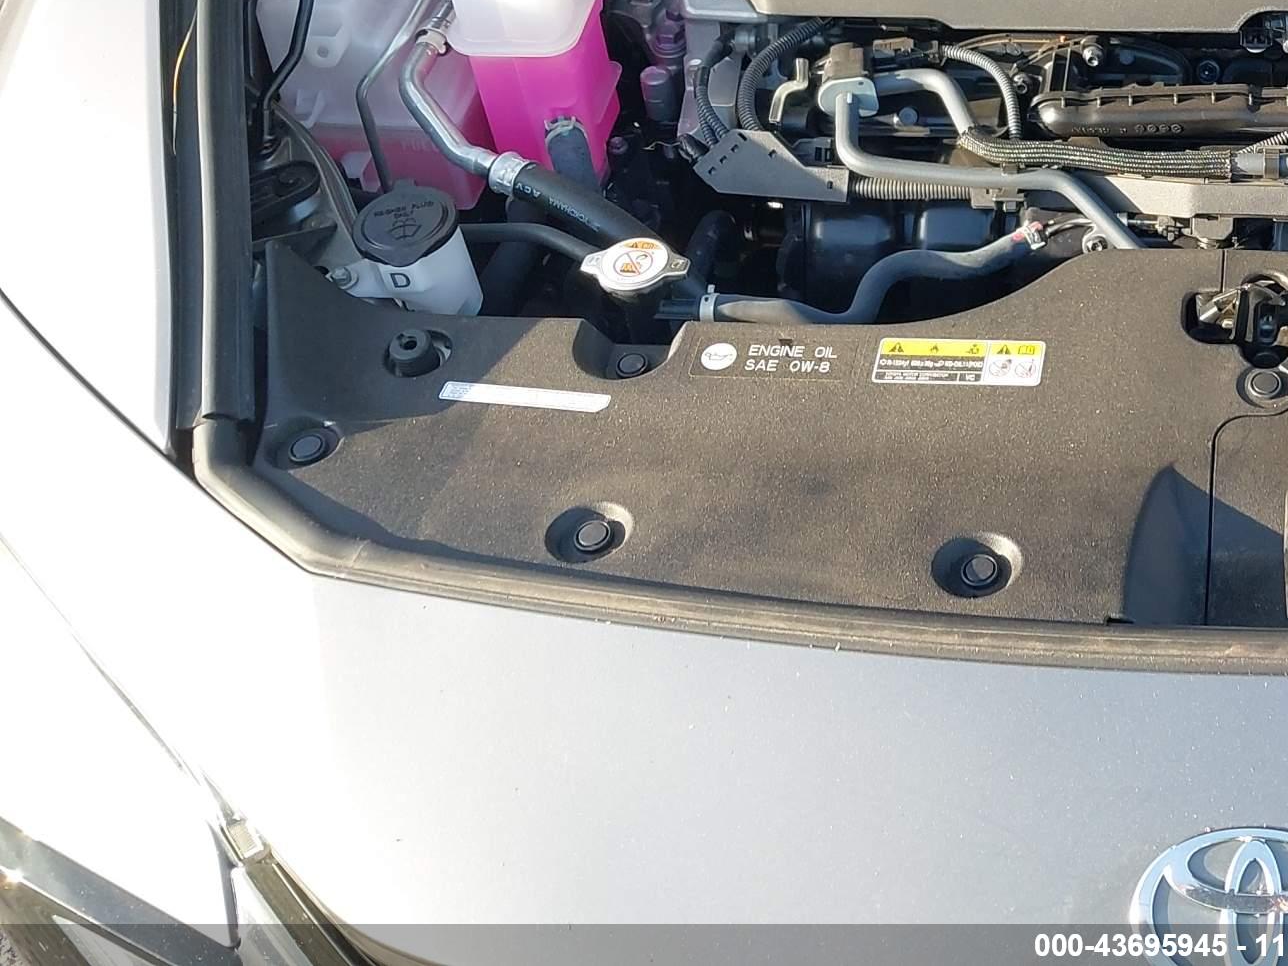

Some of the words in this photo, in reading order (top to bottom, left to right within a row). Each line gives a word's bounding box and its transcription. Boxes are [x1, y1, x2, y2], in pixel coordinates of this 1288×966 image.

[515, 182, 541, 199] ACV
[390, 272, 411, 288] D
[748, 344, 805, 357] ENGINE
[814, 346, 838, 359] OIL
[744, 359, 779, 372] SAE
